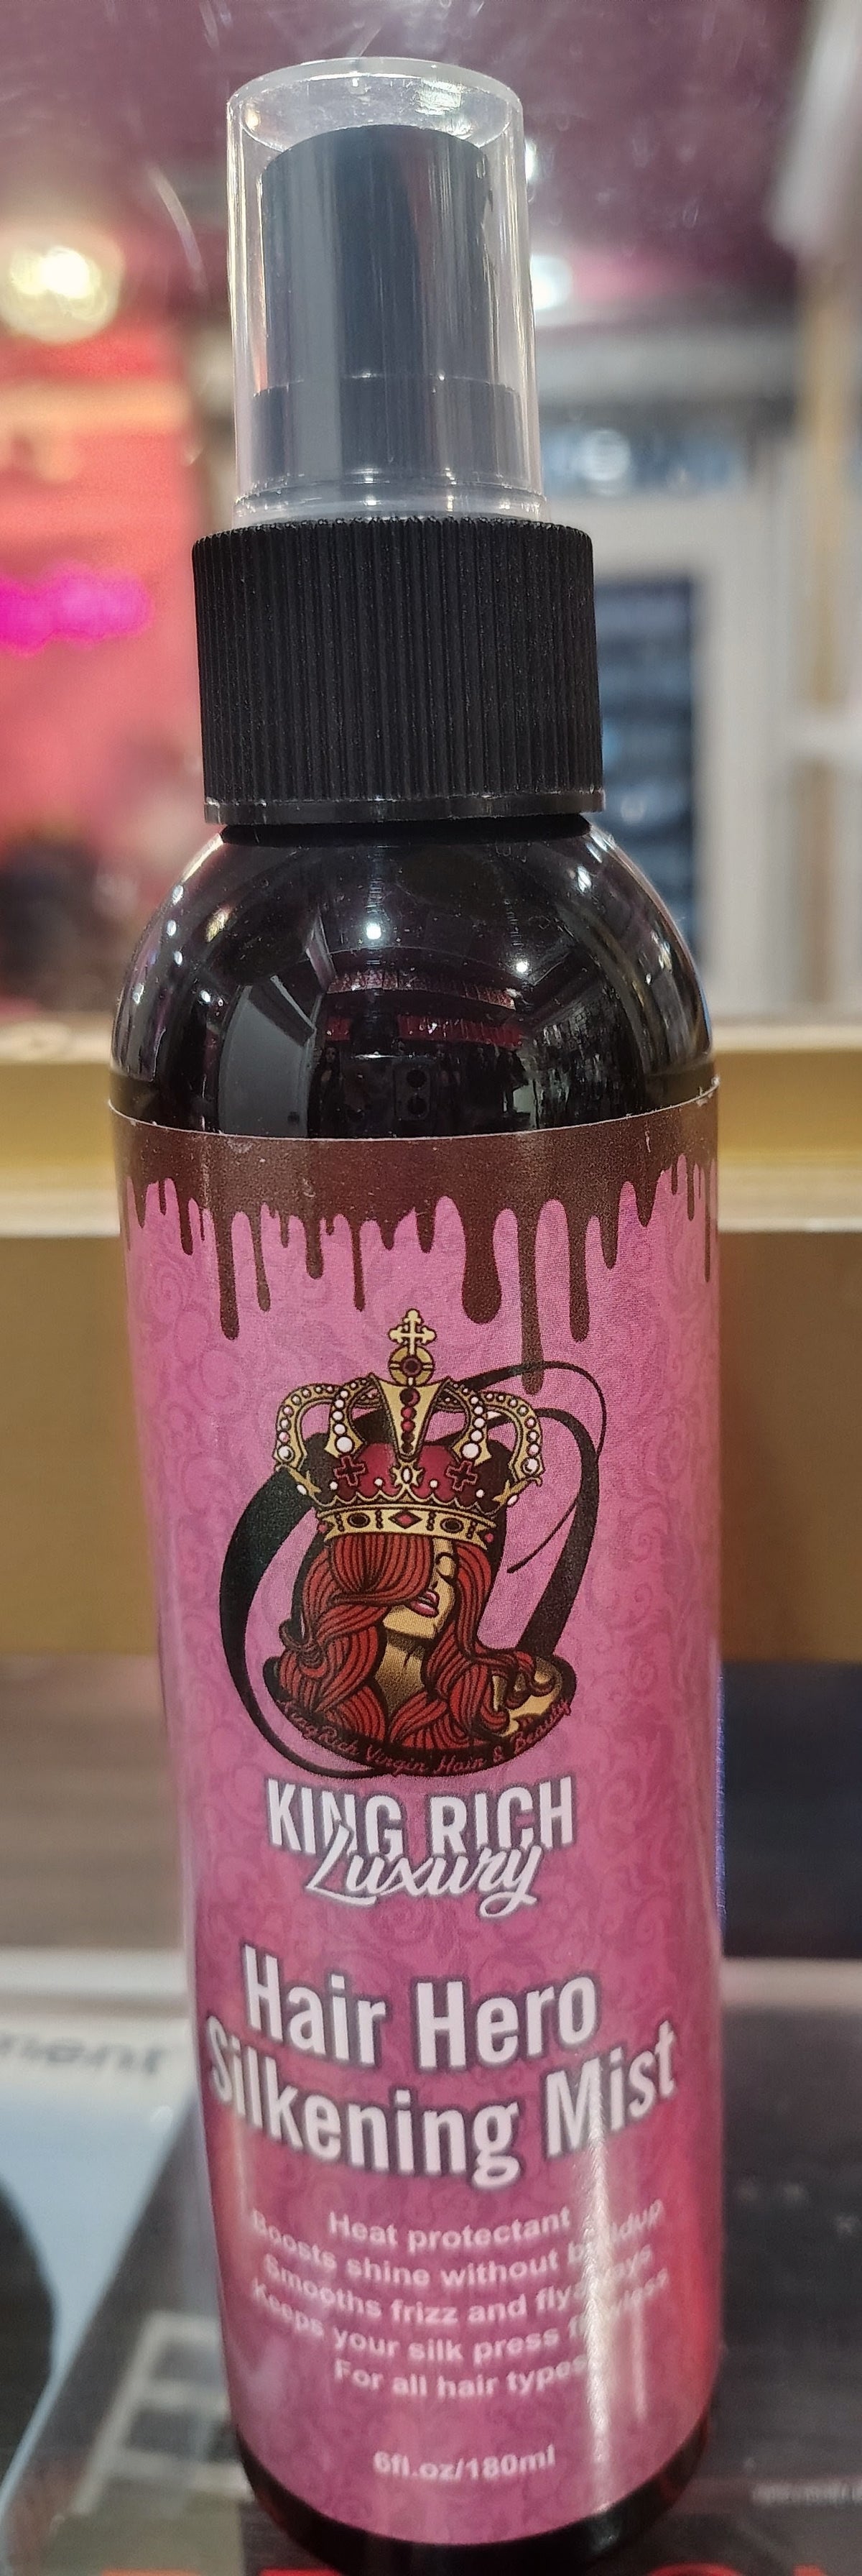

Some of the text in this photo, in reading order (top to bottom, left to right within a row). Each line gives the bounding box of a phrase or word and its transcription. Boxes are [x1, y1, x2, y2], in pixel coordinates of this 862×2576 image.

[366, 1744, 427, 1777] Virgin
[433, 1754, 487, 1775] Hair
[267, 1775, 573, 1862] KING RICH
[306, 1824, 543, 1918] Luxury
[244, 1944, 597, 2069] Hair Hero
[207, 2015, 677, 2189] Silkening Mist
[252, 2199, 665, 2287] Boosts shine without bldup
[329, 2206, 572, 2253] Heat protectant
[252, 2278, 324, 2337] Keeps
[333, 2325, 401, 2358] your
[407, 2336, 464, 2363] silk
[473, 2326, 560, 2365] press
[264, 2245, 652, 2324] Smooths frizz and flyaays
[334, 2353, 589, 2398] For all hair types
[373, 2444, 557, 2482] 6fl.oz/180ml
